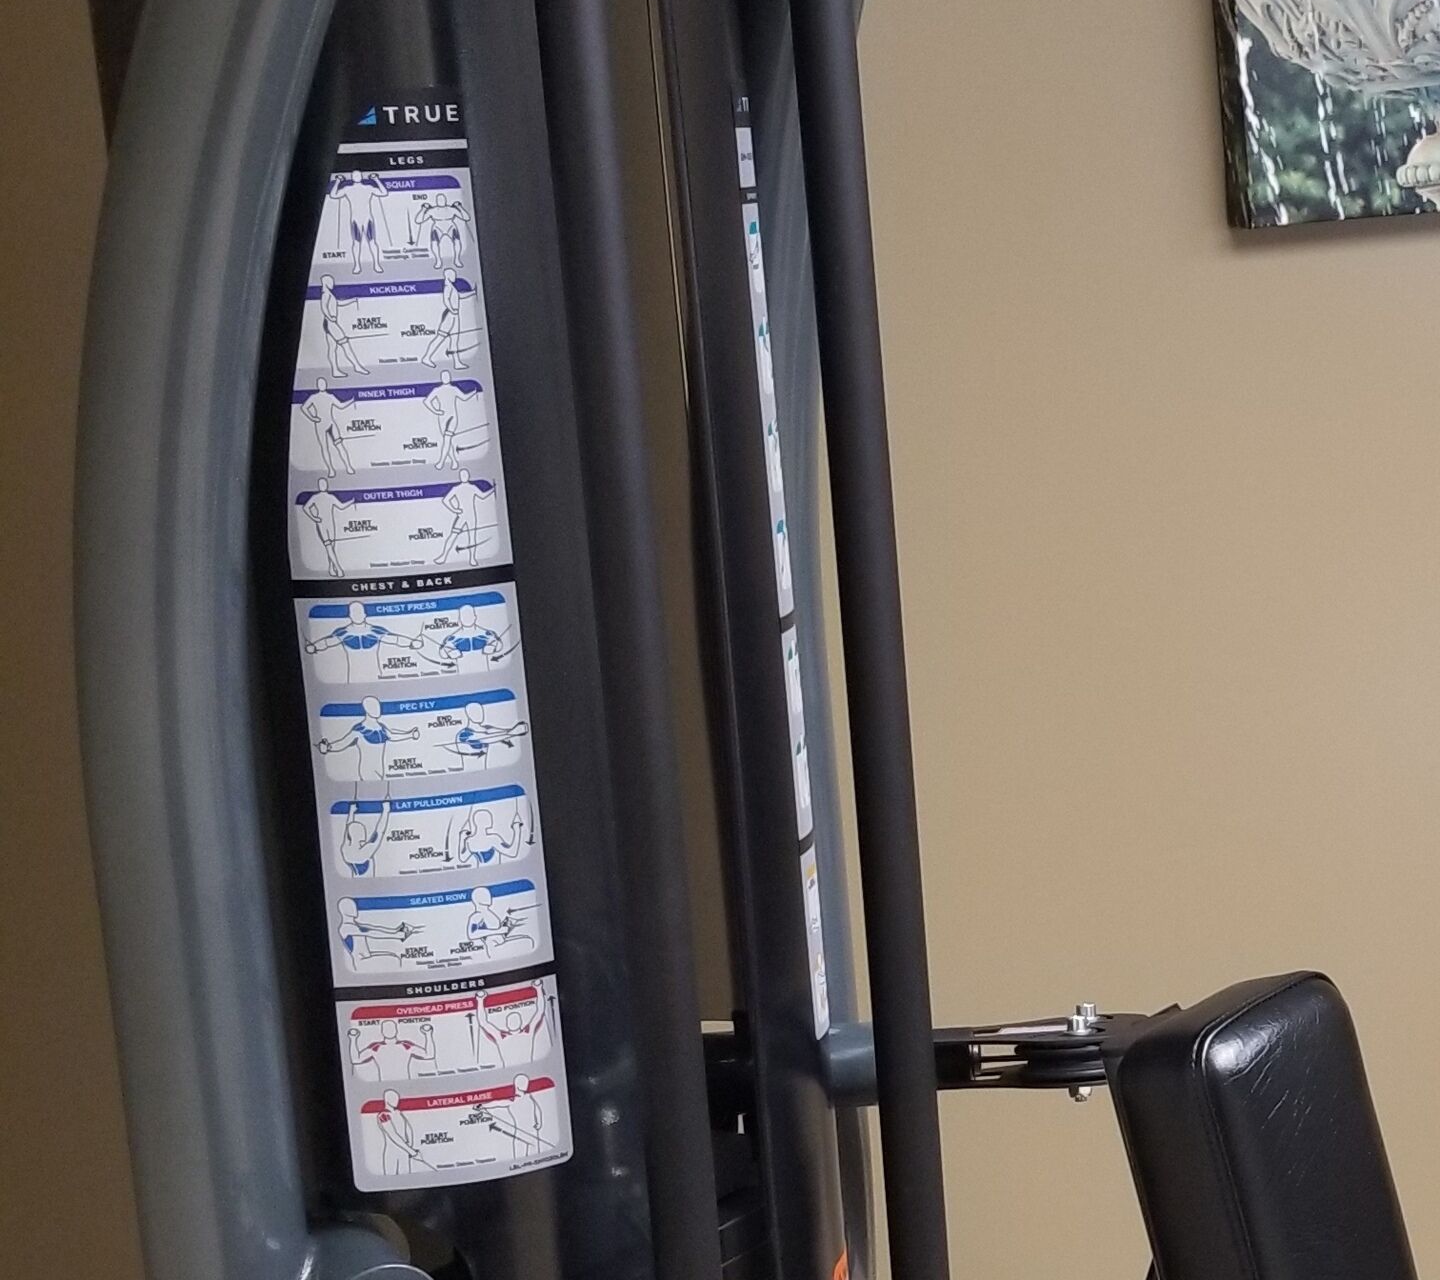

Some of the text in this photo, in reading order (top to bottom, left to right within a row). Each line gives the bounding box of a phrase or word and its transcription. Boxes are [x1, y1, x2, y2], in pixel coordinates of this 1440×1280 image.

[383, 104, 459, 124] TRUE
[389, 156, 424, 165] LEGS
[386, 180, 416, 189] SQUAT
[369, 285, 416, 294] KICKBACK
[358, 388, 415, 398] INNER THIGH
[364, 489, 423, 500] OUTER THIGH
[352, 576, 452, 591] CHEST & BACK
[376, 602, 437, 613] CHEST PRESS
[388, 656, 411, 664] START
[399, 701, 435, 711] PEC FLY
[395, 796, 463, 810] LAT PULLDOWN
[410, 893, 467, 906] SEATED ROW
[407, 979, 485, 995] SHOULDERS
[397, 1001, 474, 1015] OVERHEAD PRESS
[427, 1092, 492, 1107] LATERAL RAISE
